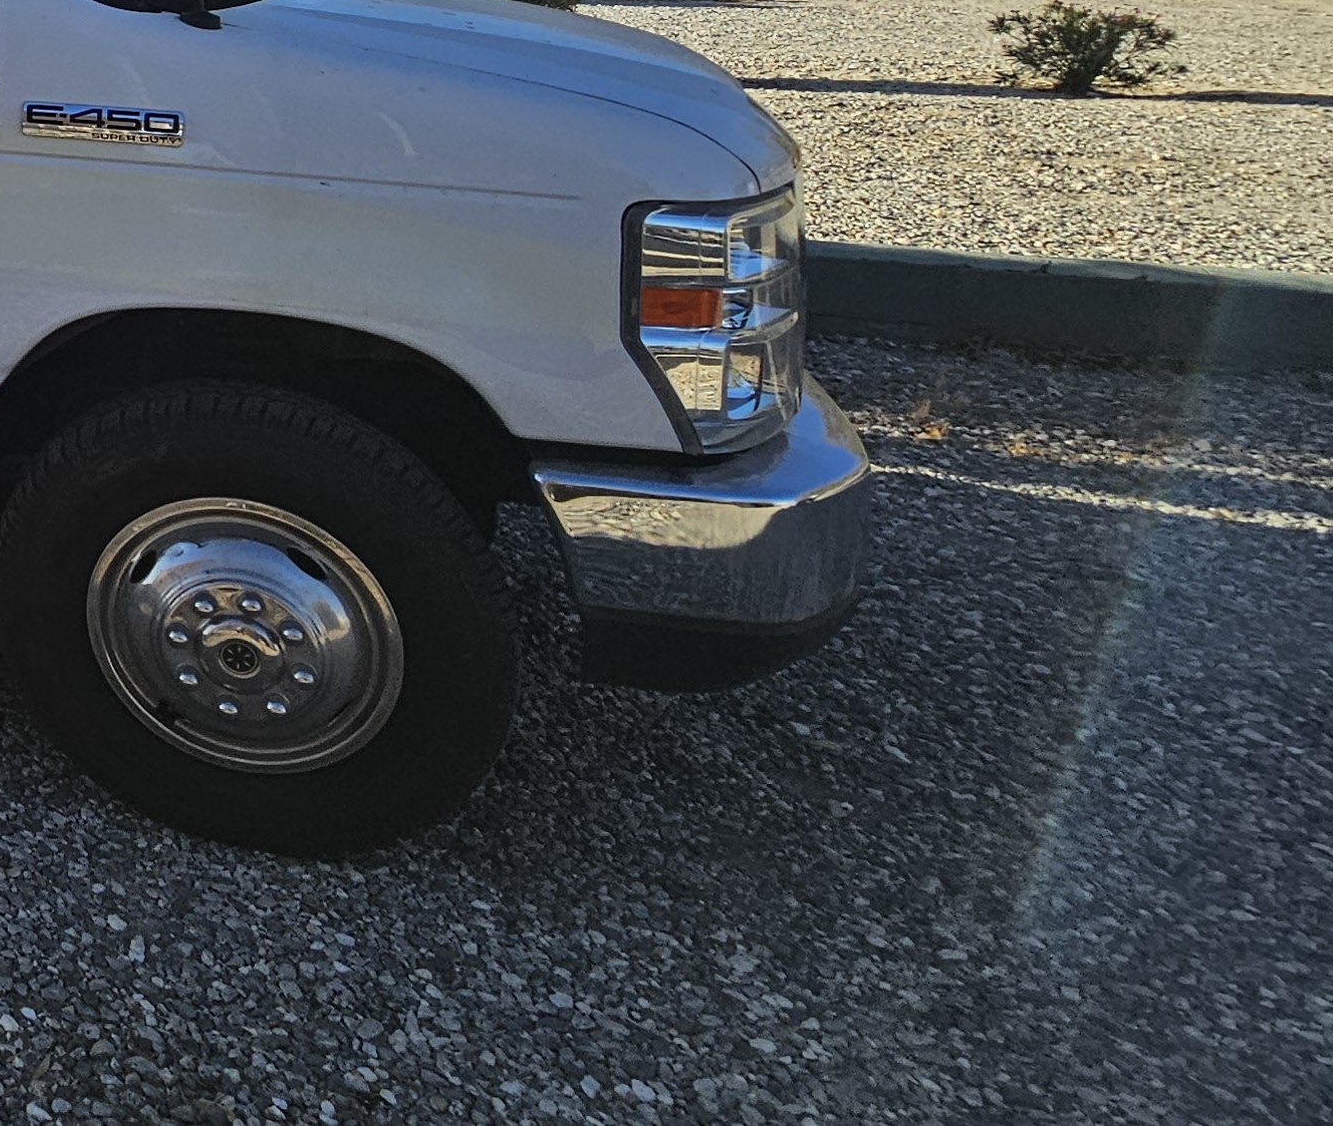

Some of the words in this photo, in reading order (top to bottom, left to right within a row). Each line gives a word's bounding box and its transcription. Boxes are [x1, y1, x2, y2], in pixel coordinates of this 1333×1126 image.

[26, 104, 180, 134] E-450
[91, 132, 136, 142] SUPER
[139, 135, 182, 145] DUTY
